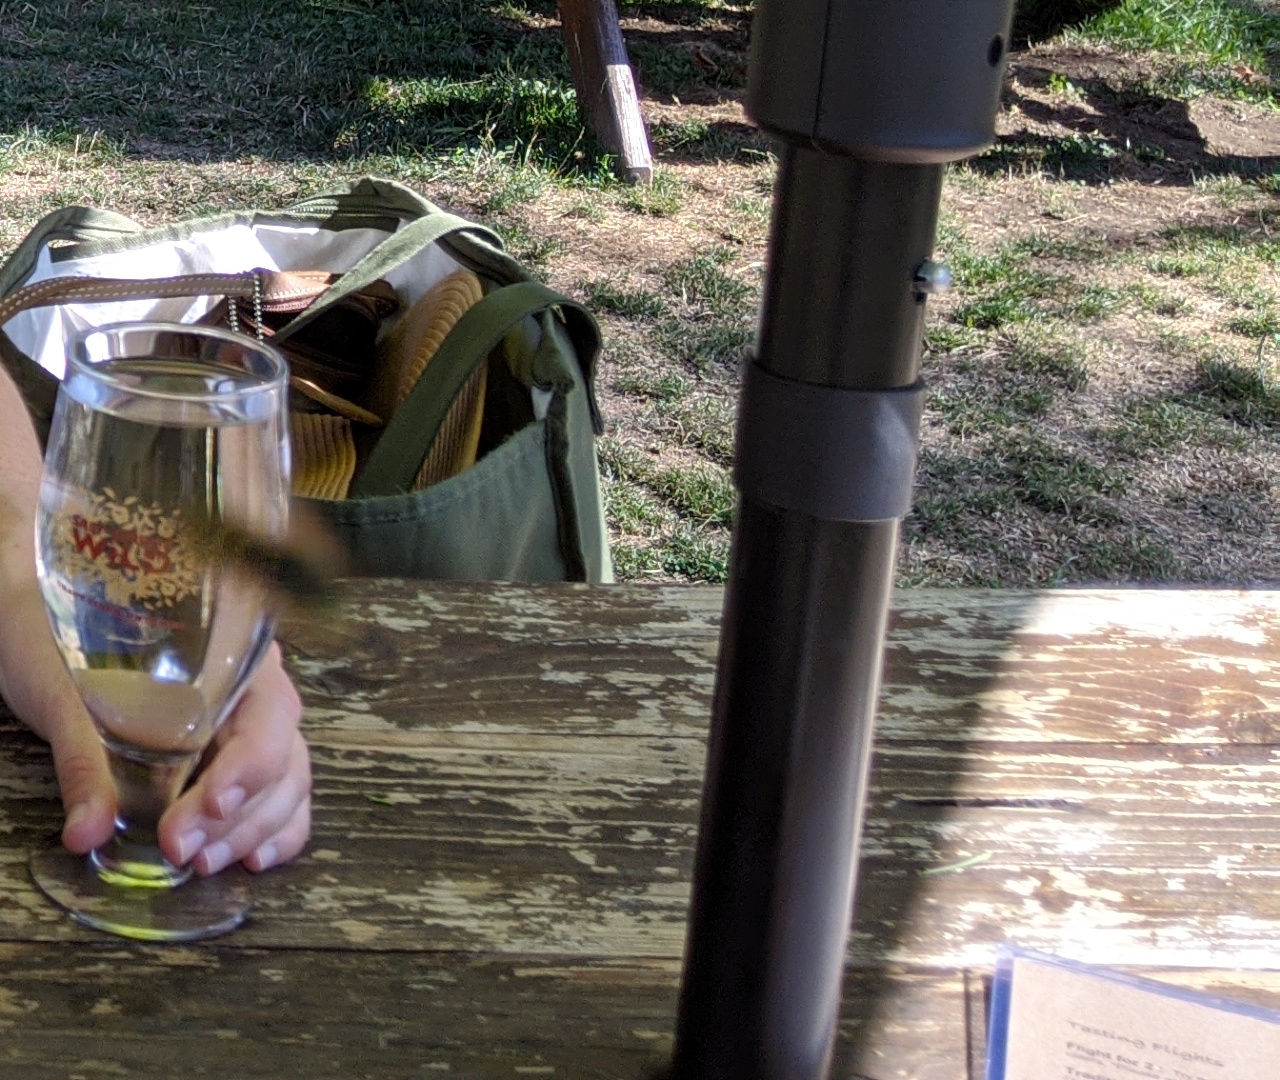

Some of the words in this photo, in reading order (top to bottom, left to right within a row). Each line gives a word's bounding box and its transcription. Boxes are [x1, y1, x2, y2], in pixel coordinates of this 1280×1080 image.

[1066, 1020, 1146, 1049] Tasting
[1152, 1041, 1225, 1068] Flights
[1066, 1040, 1113, 1060] Flight
